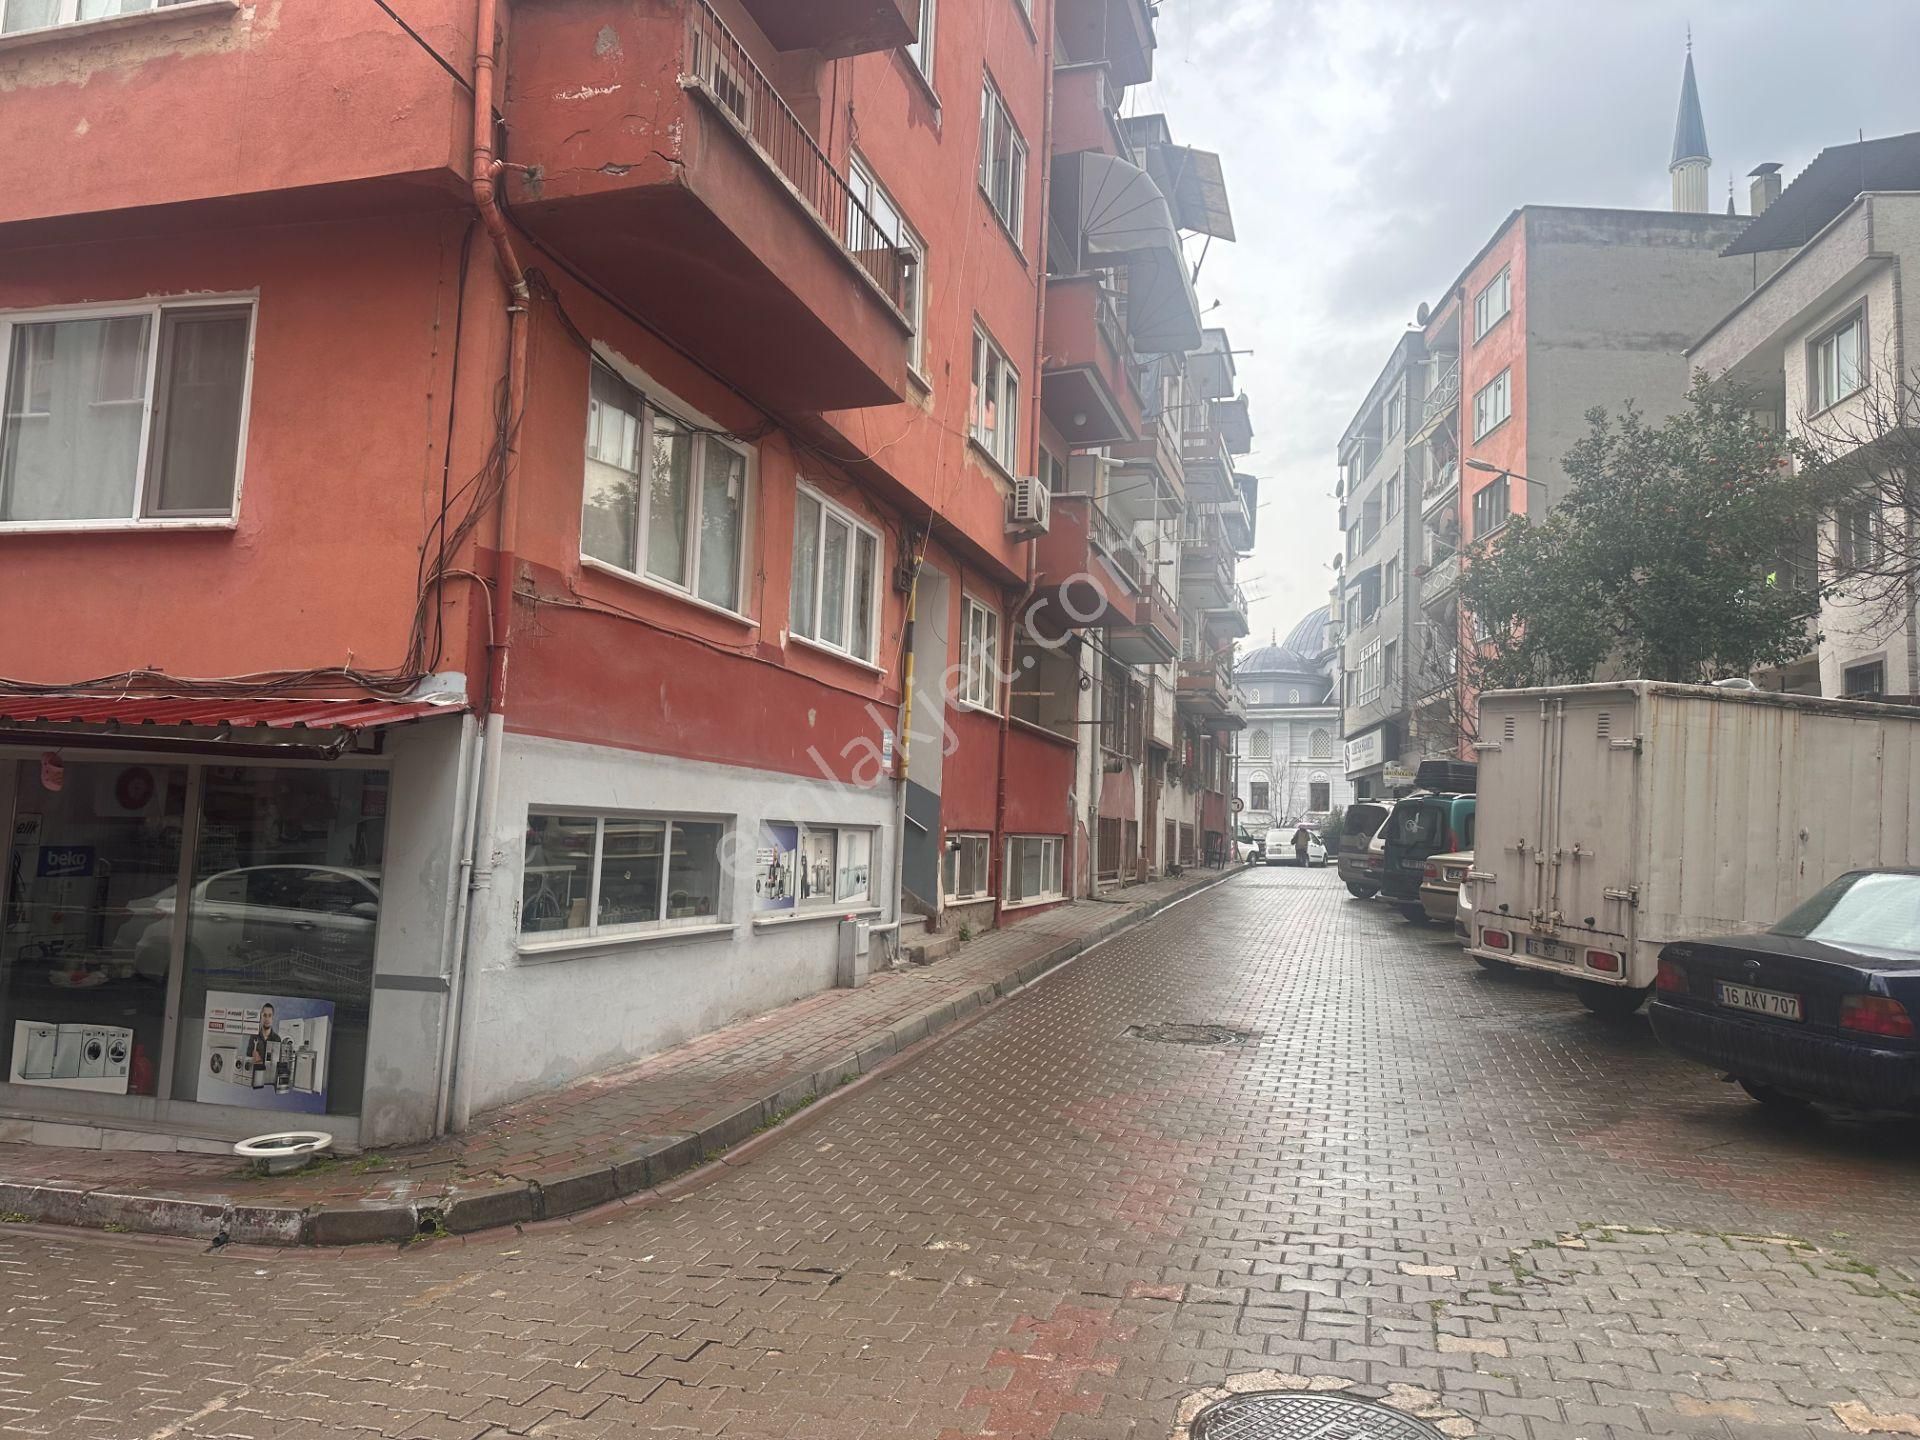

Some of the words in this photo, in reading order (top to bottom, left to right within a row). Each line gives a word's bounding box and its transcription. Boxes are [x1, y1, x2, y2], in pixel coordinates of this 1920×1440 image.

[47, 851, 87, 866] beko
[1725, 987, 1739, 1004] 16
[1744, 991, 1767, 1010] AKV
[1771, 996, 1797, 1015] 707
